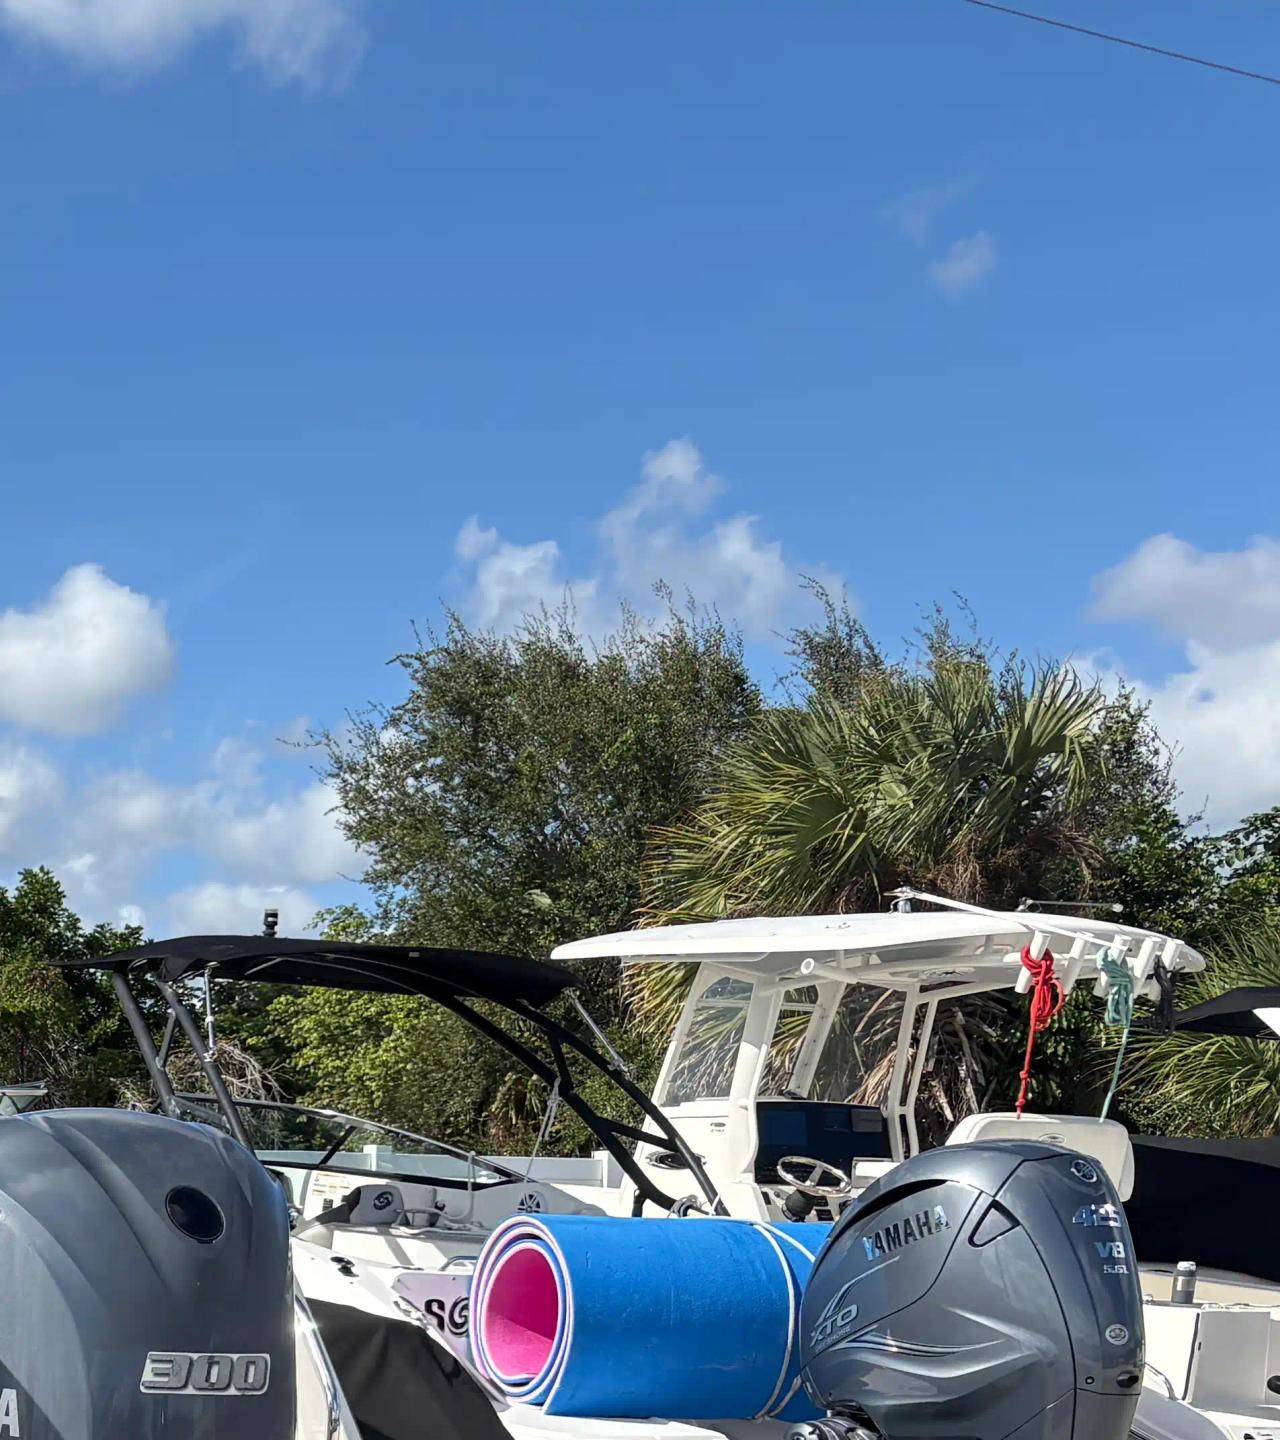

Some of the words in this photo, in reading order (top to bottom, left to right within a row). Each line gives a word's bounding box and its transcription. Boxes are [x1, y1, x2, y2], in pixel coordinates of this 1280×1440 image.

[862, 1204, 951, 1262] YAMAHA
[1094, 1241, 1126, 1258] V8
[810, 1304, 858, 1348] XTO
[142, 1353, 269, 1392] 300
